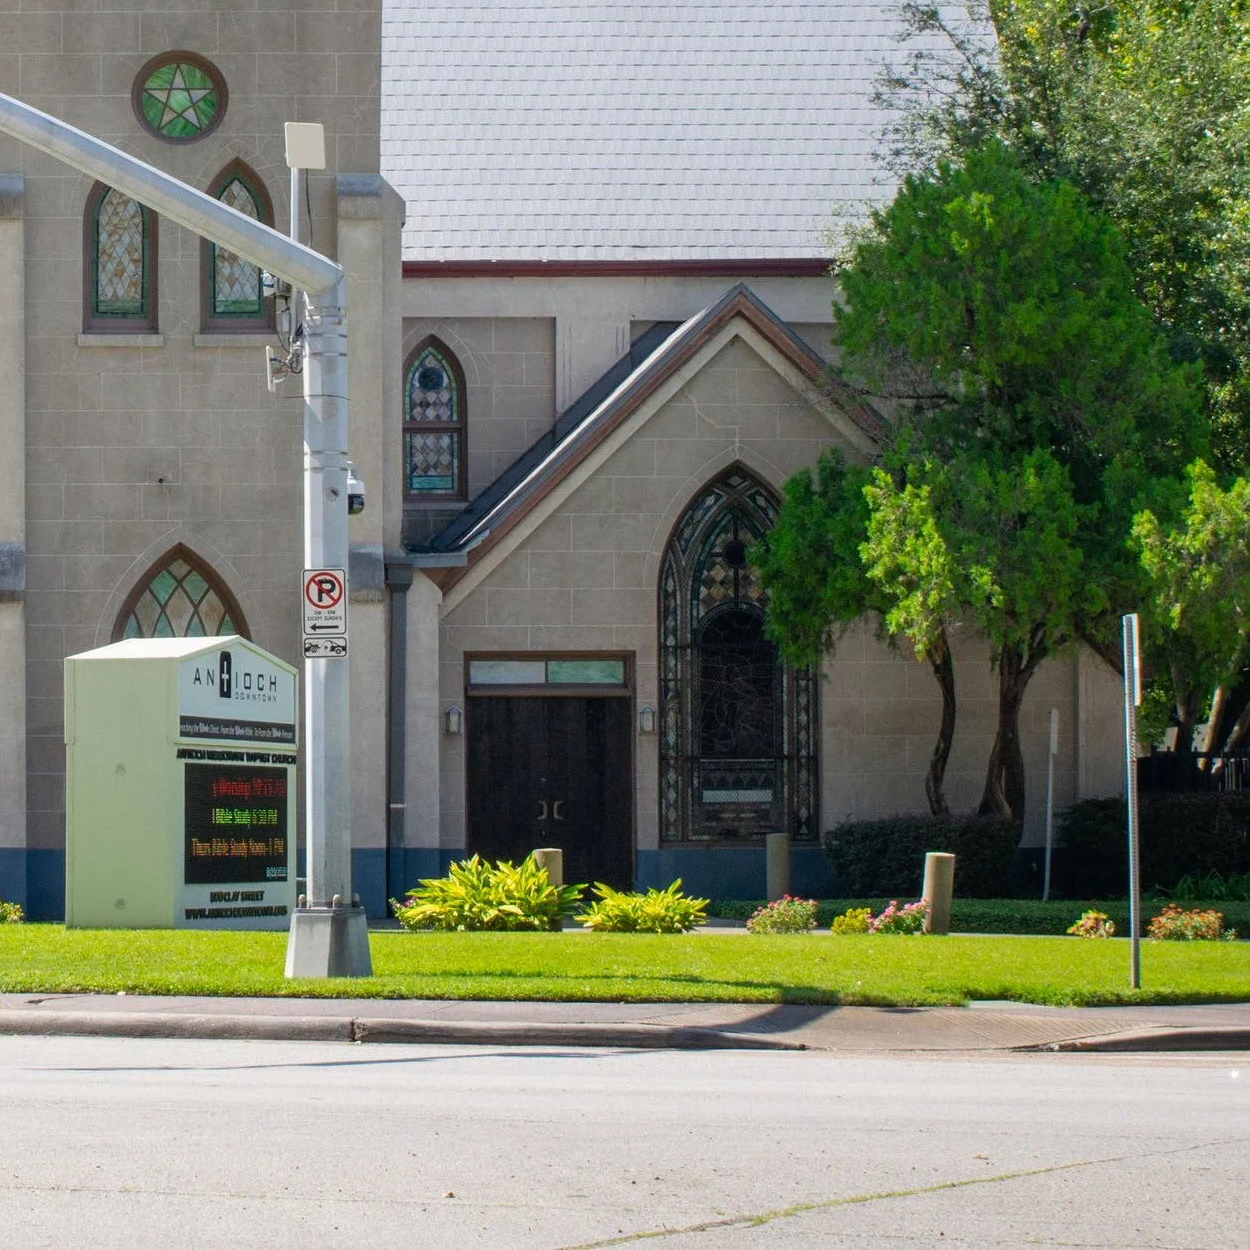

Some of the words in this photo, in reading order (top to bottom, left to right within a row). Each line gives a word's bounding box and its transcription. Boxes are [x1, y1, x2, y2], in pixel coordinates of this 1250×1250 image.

[235, 692, 277, 703] DOWNTOWN
[272, 753, 297, 764] CHURCH
[234, 808, 251, 829] Study
[268, 809, 278, 824] PM
[212, 838, 229, 856] Bible
[230, 838, 248, 858] Study
[240, 890, 265, 902] STREET
